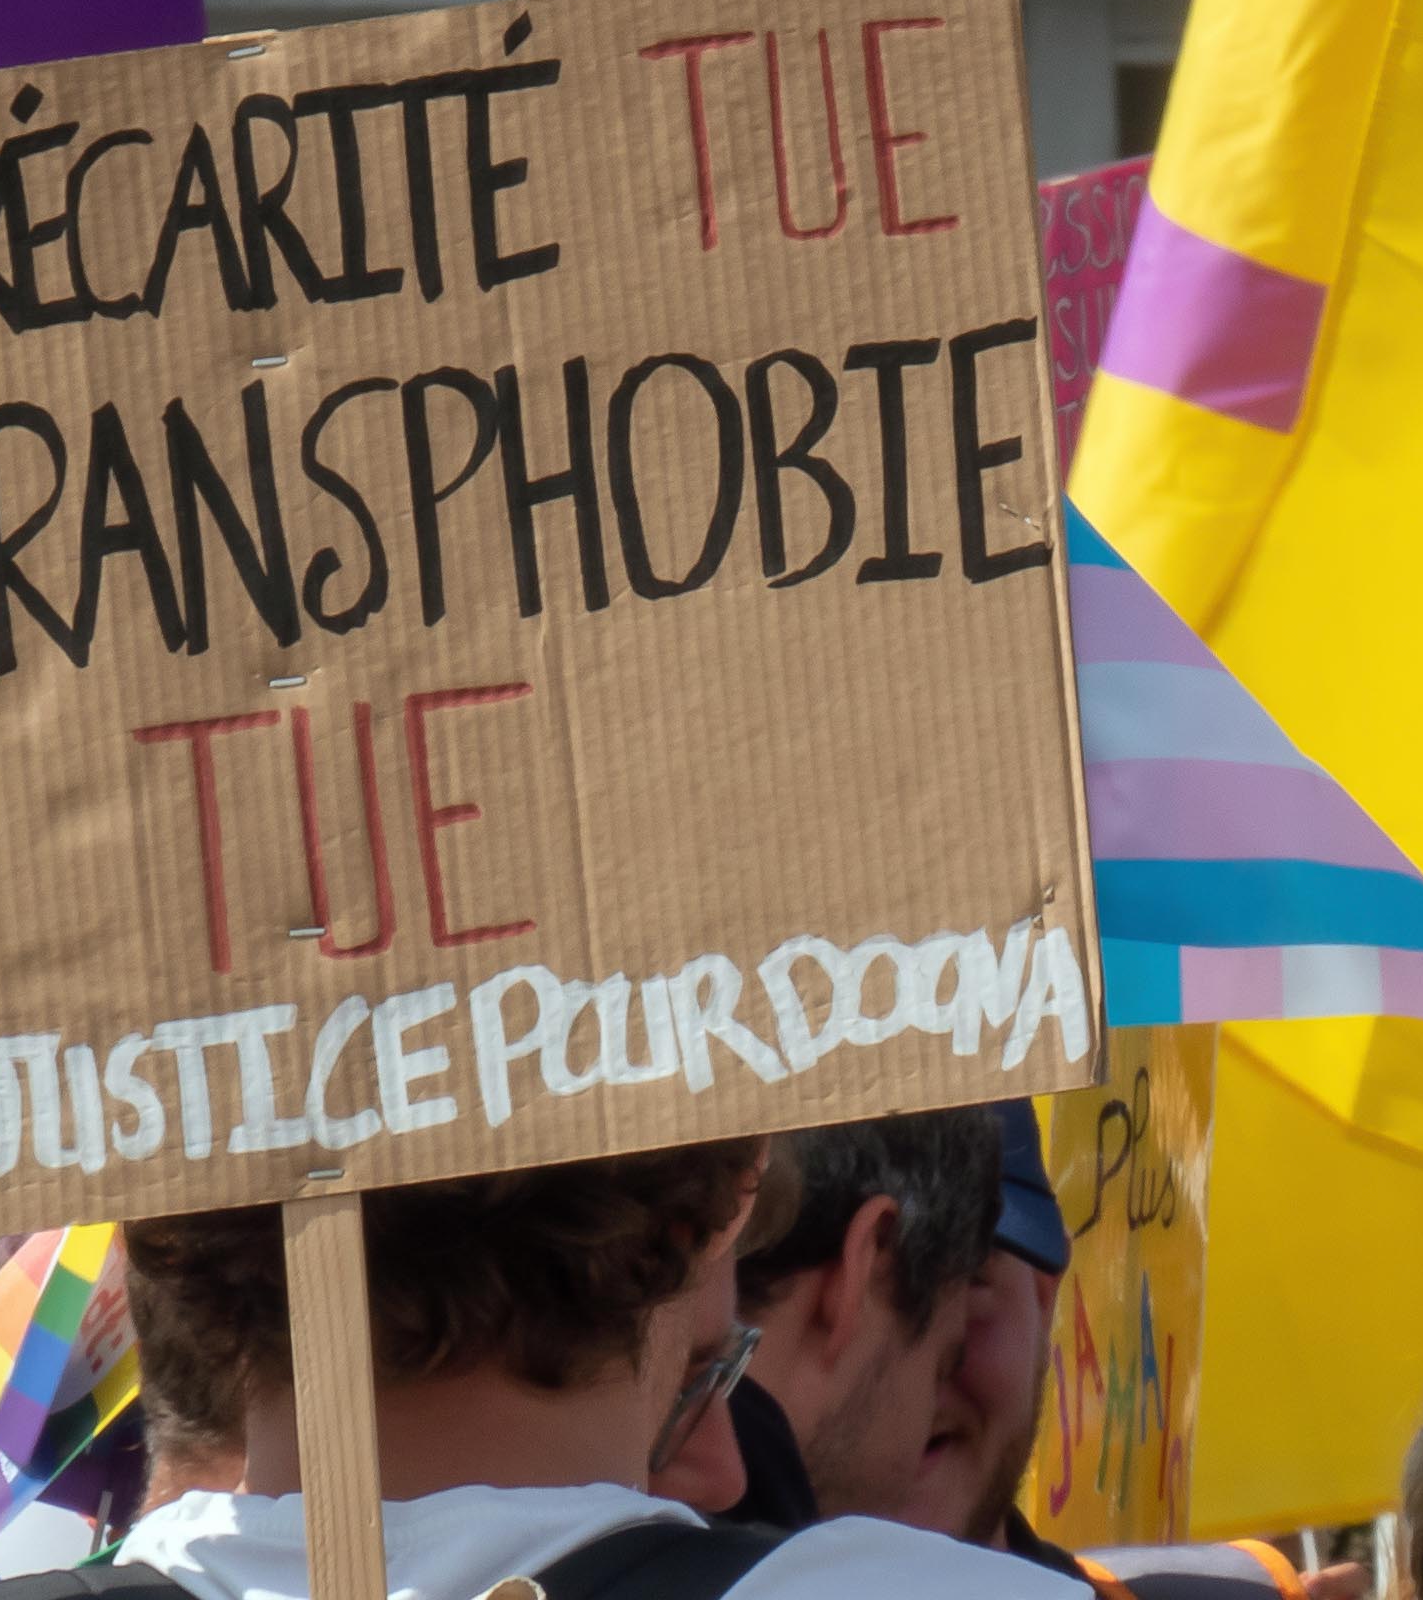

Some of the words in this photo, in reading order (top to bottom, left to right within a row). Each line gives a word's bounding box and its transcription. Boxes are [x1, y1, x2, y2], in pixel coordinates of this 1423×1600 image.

[639, 17, 960, 251] TUE
[133, 682, 537, 975] TUE
[1073, 1065, 1177, 1238] Plus
